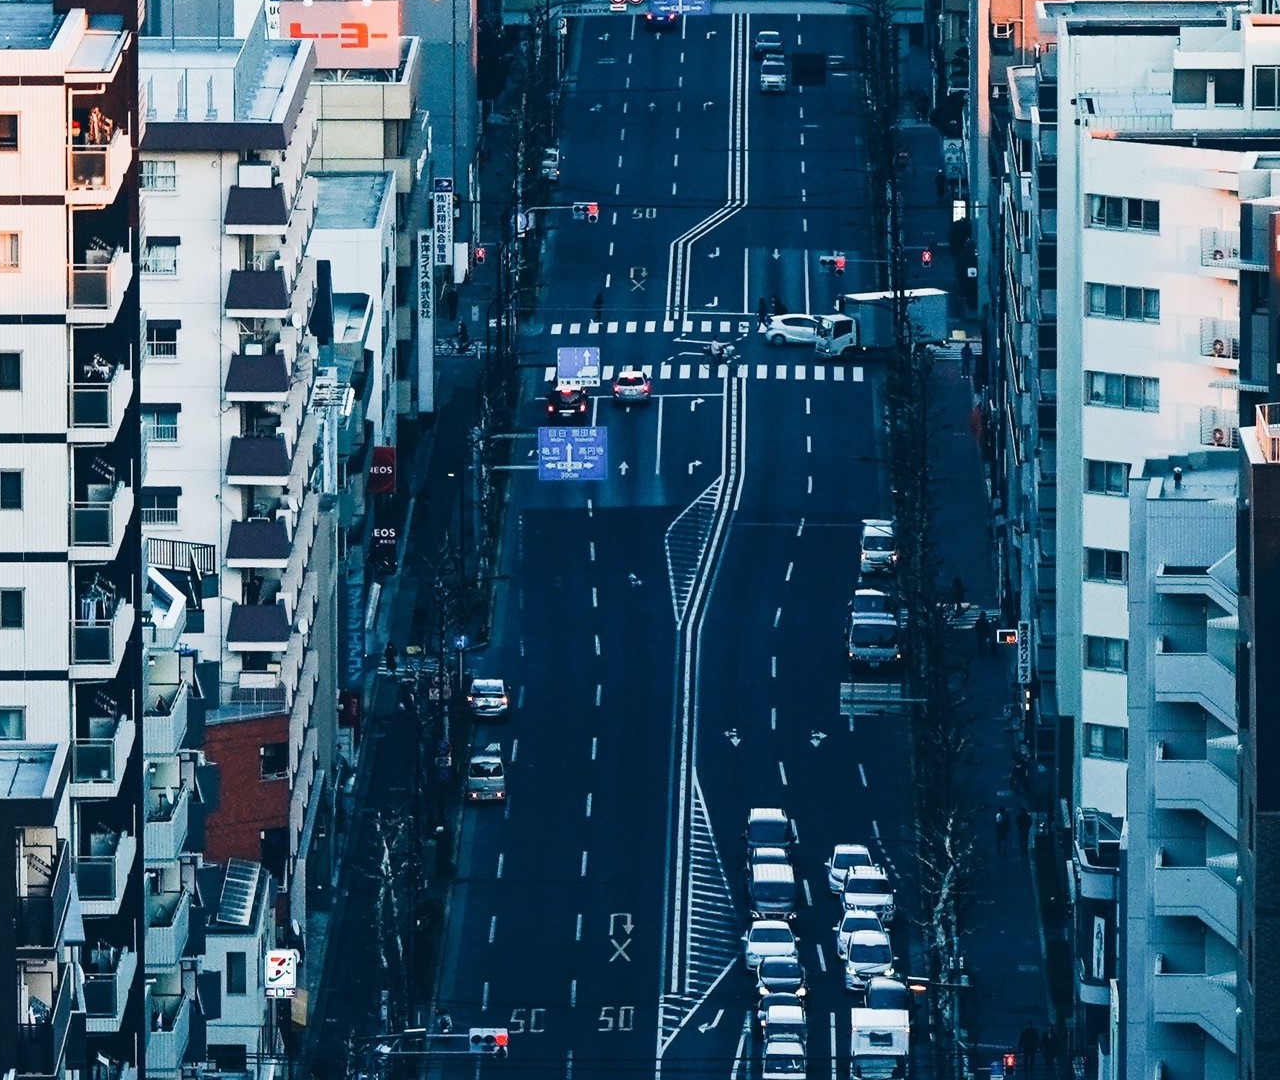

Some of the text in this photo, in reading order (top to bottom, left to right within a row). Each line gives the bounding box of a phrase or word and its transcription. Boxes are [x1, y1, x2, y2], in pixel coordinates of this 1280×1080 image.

[420, 234, 431, 319] 東洋ライス株式会社
[372, 528, 396, 537] EOS
[598, 1006, 634, 1031] 50
